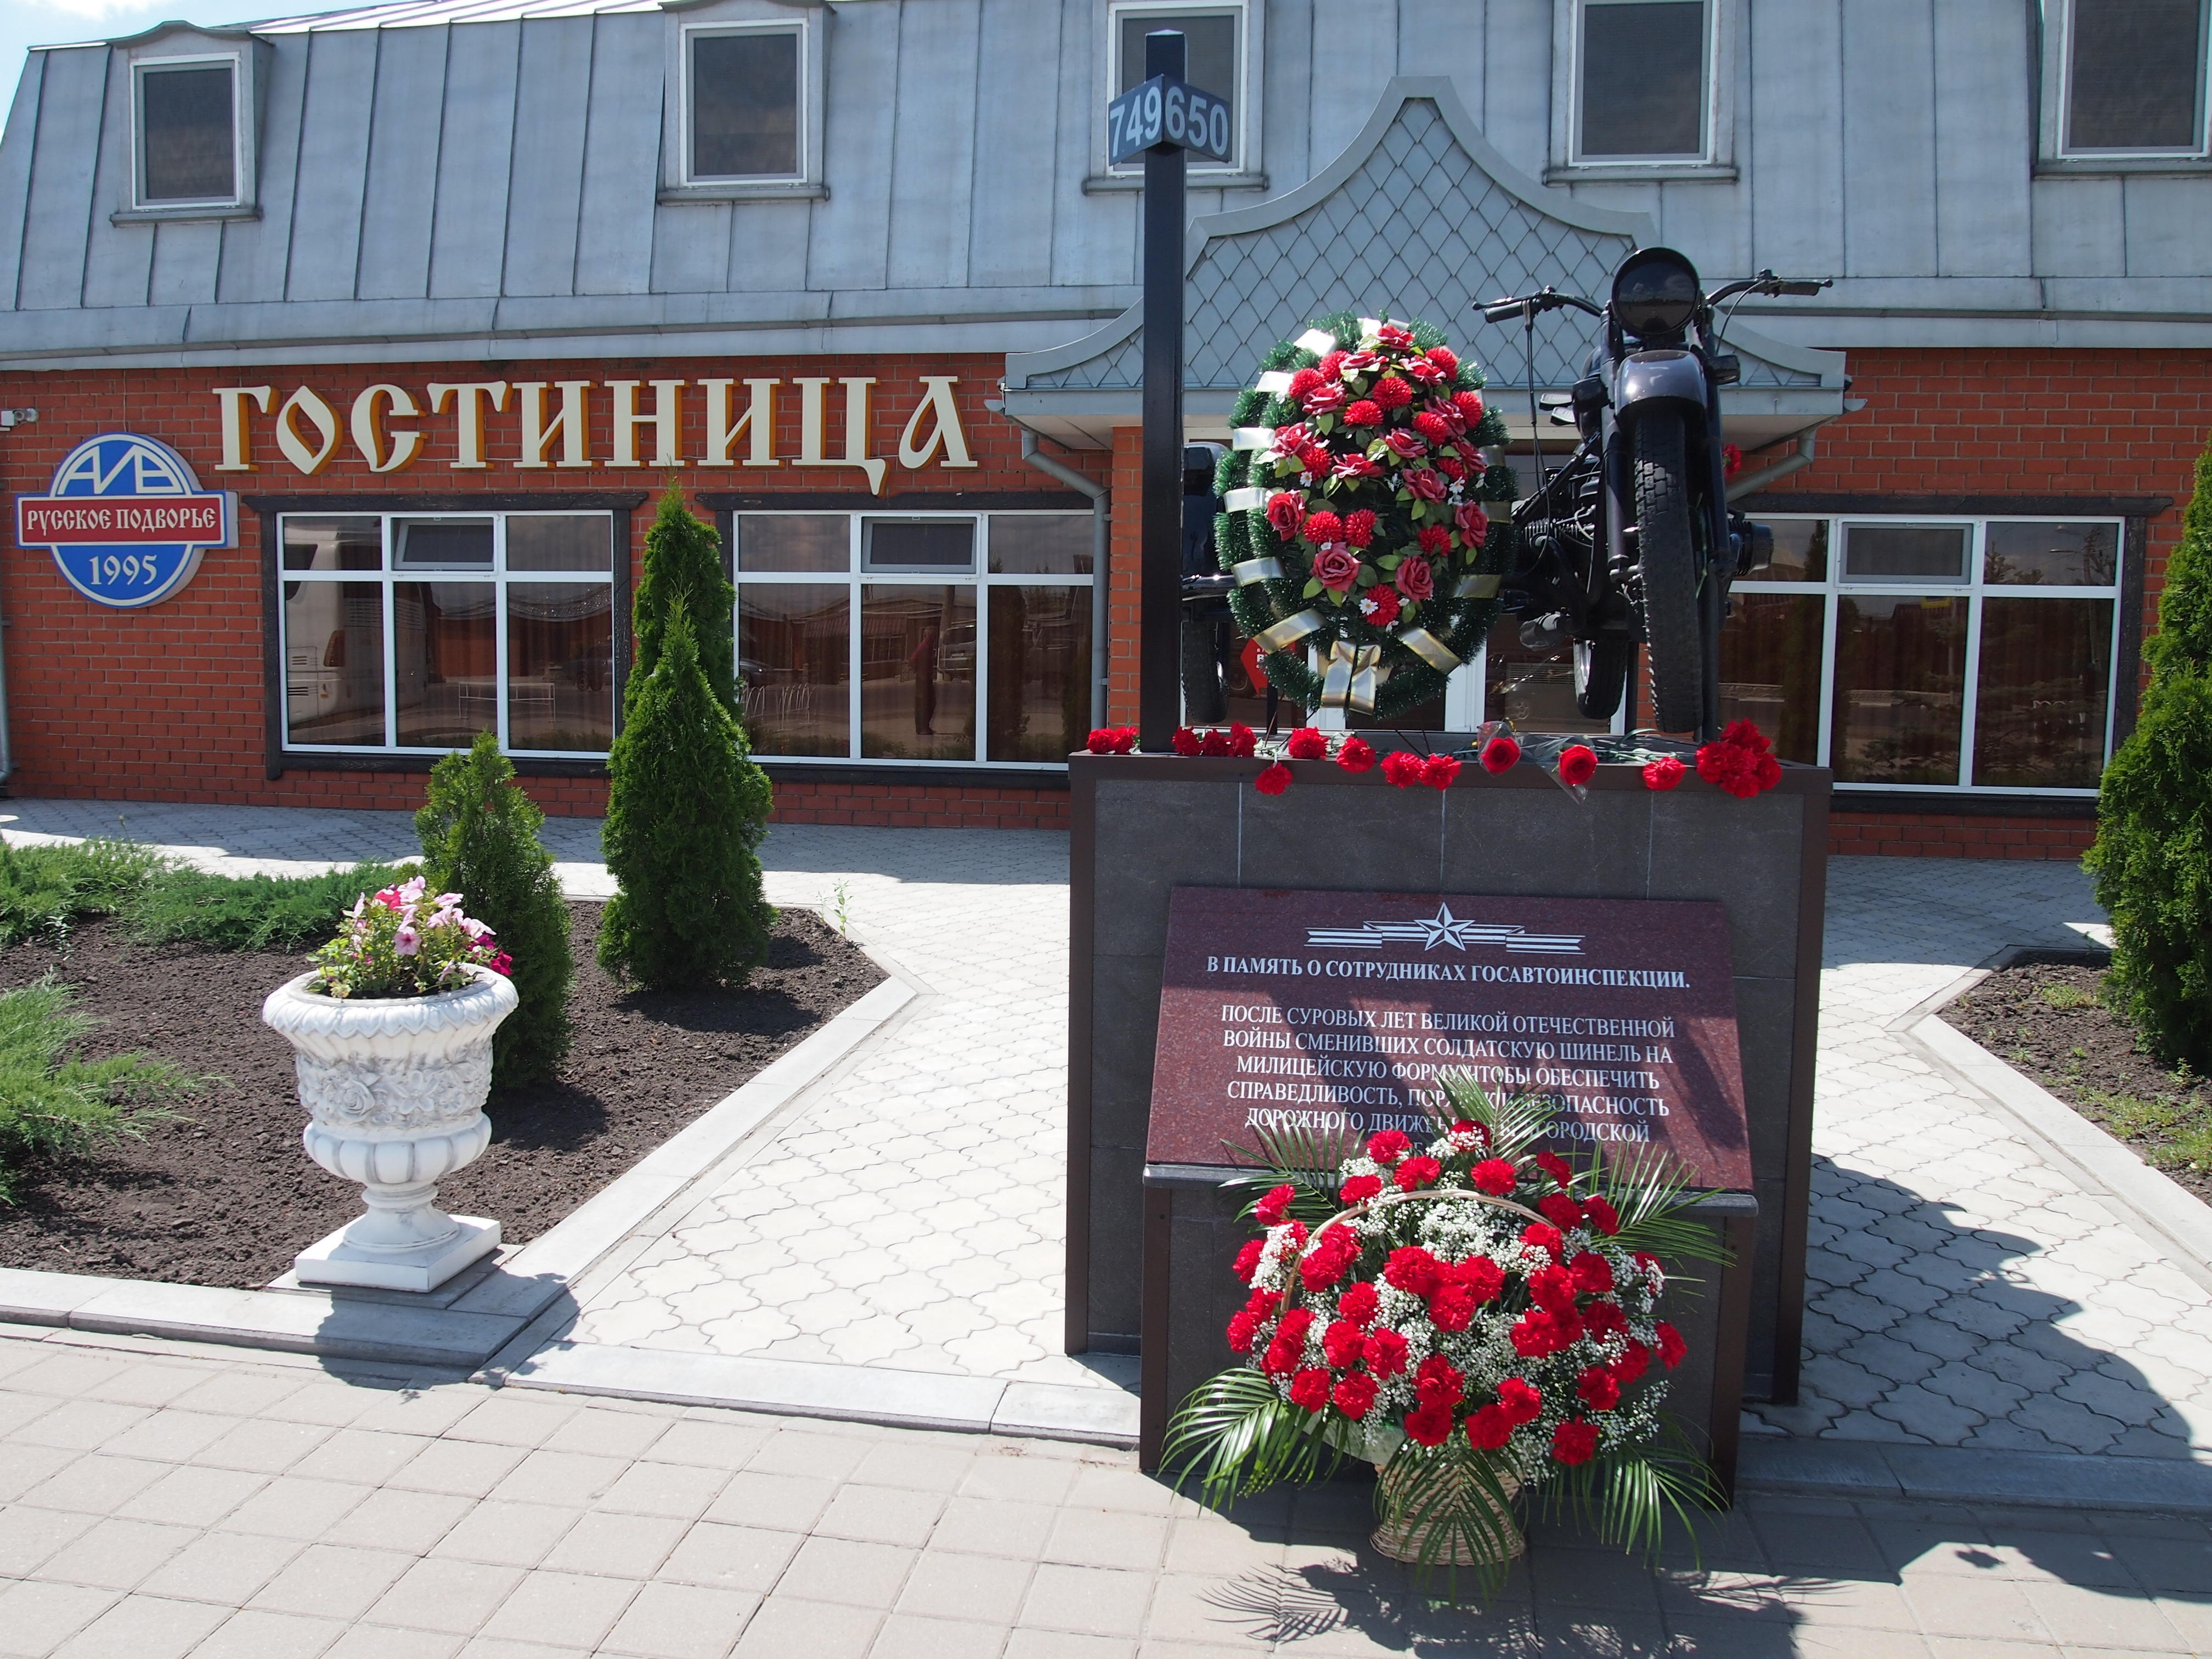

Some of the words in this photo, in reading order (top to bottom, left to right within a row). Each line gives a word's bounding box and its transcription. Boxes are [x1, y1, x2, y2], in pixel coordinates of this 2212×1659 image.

[212, 375, 979, 496] ГОСТИНИЦА
[26, 509, 112, 536] РУССКОЕ
[115, 507, 216, 533] ПОДВОРЬЕ
[88, 554, 158, 586] 1995
[1207, 956, 1218, 972] В
[1222, 956, 1303, 975] ПАМЯТЬ
[1307, 960, 1321, 977] О
[1325, 960, 1467, 982] СОТРУДНИКАХ
[1471, 965, 1691, 990] ГОСАВТОИНСПЕКЦИИ.
[1221, 1005, 1283, 1024] ПОСЛЕ
[1286, 1007, 1377, 1028] СУРОВЫХ
[1380, 1011, 1416, 1029] ЛЕТ
[1421, 1011, 1508, 1033] ВЕЛИКОЙ
[1513, 1015, 1675, 1039] ОТЕЧЕСТВЕННОЙ
[1223, 1026, 1291, 1049] ВОЙНЫ
[1295, 1032, 1420, 1055] СМЕНИВШИХ
[1424, 1038, 1555, 1060] СОЛДАТСКУЮ
[1560, 1042, 1641, 1063] ШИНЕЛЬ
[1646, 1046, 1674, 1064] НА
[1237, 1054, 1387, 1079] МИЛИЦЕЙСКУЮ
[1536, 1066, 1660, 1090] ОБЕСПЕЧИТЬ
[1227, 1080, 1403, 1109] СПРАВЕДЛИВОСТЬ,
[1408, 1088, 1495, 1109] ПОРК
[1244, 1107, 1364, 1130] ДОРОЖНОГО
[1368, 1113, 1464, 1135] ДВИЖЕН
